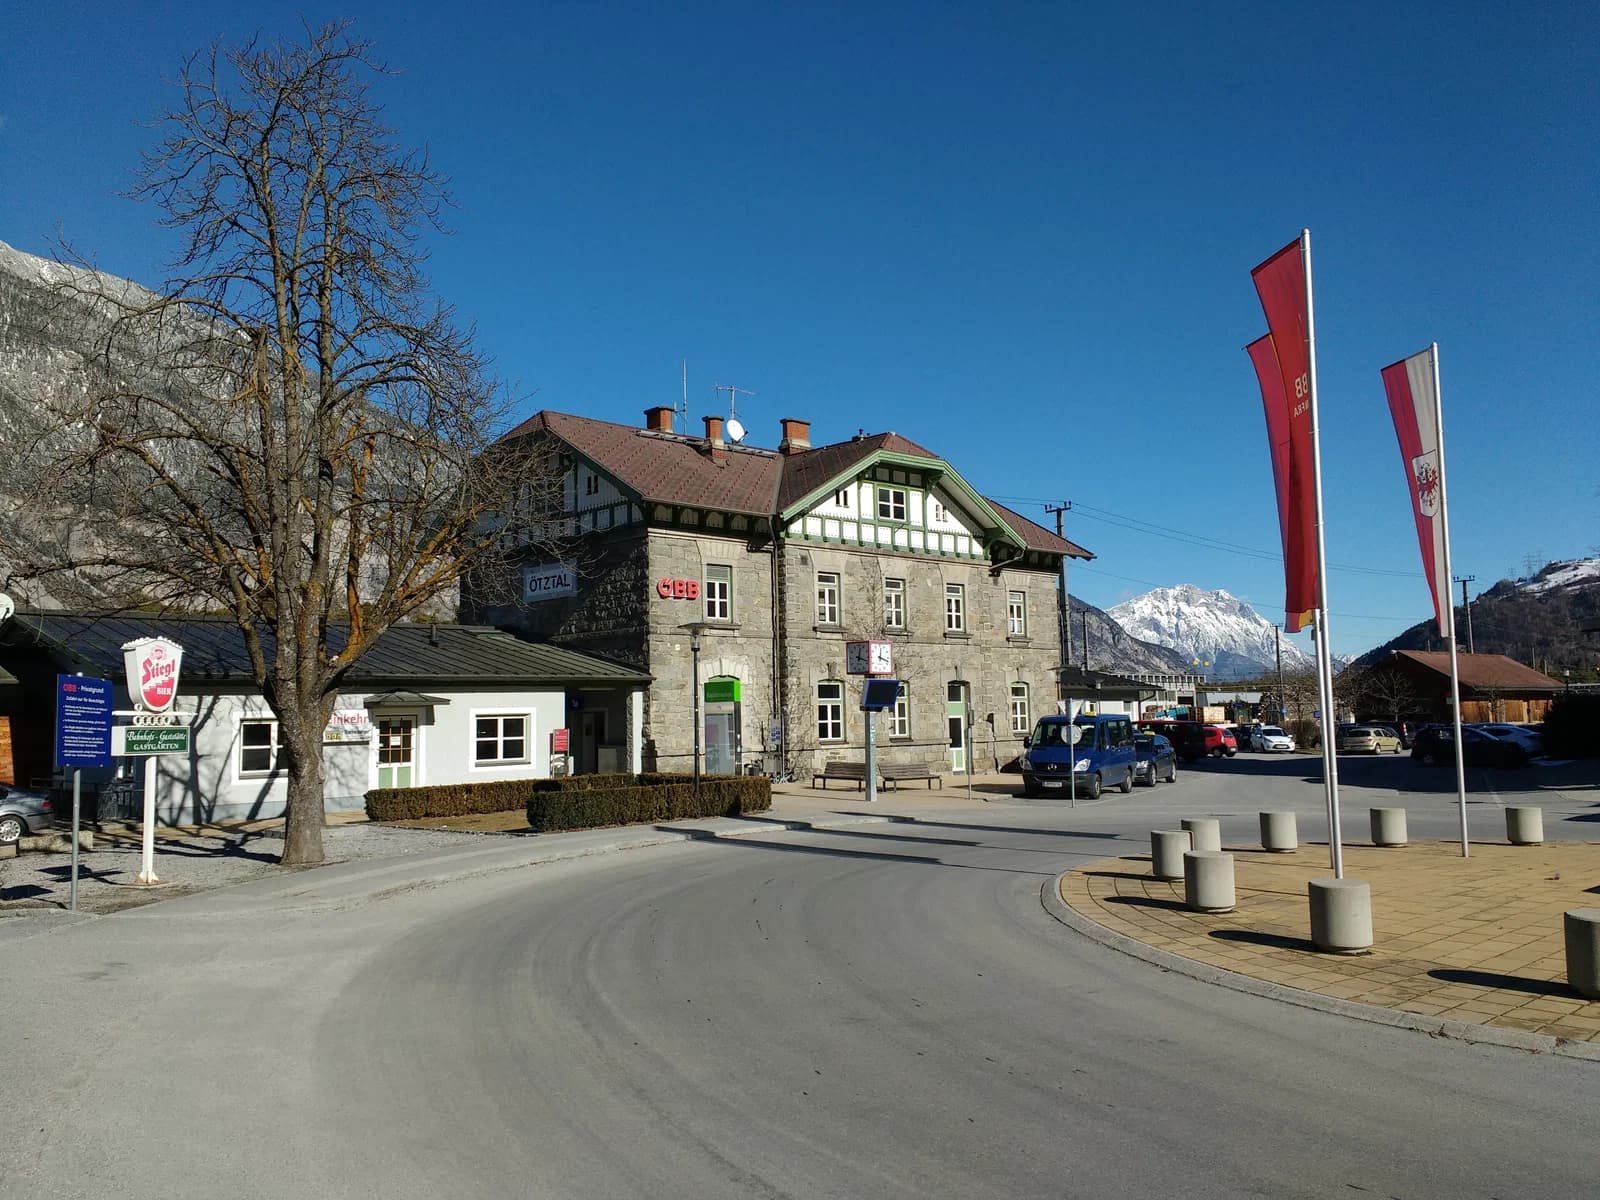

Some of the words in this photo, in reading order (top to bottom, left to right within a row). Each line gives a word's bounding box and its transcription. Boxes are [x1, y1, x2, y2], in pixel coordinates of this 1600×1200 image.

[529, 574, 570, 592] ÖTZTAL
[657, 578, 700, 600] ÖBB
[142, 658, 175, 686] Stiegl
[156, 687, 172, 696] BIER
[330, 713, 368, 724] inkehr
